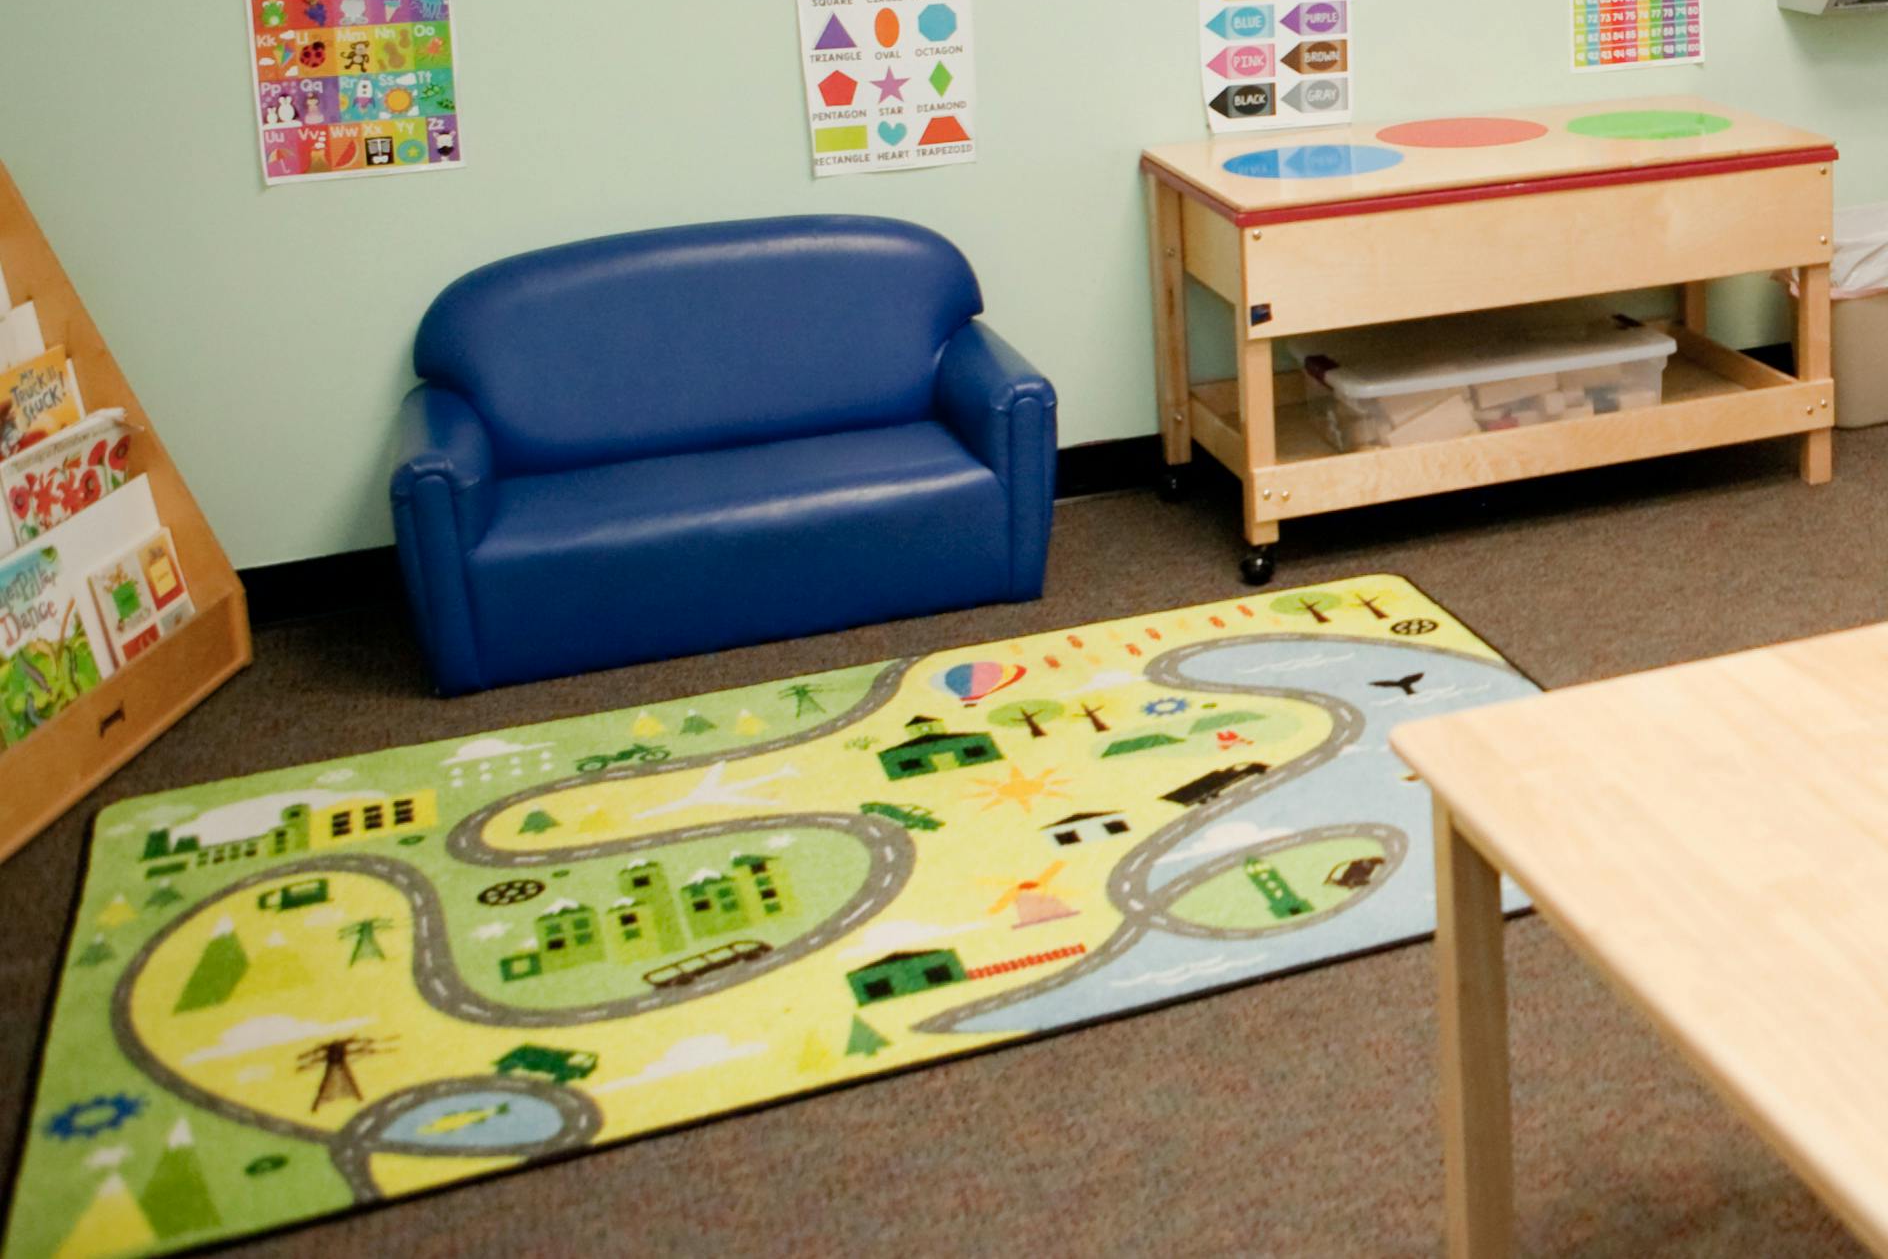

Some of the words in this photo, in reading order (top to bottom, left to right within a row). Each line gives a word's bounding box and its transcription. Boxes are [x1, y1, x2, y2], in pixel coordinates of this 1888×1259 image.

[1234, 16, 1262, 29] BLUE
[1305, 13, 1337, 24] PURPLE
[257, 35, 277, 47] Kk
[414, 25, 435, 37] Oo
[810, 52, 862, 63] TRIANGLE
[875, 52, 901, 60] OVAL
[915, 45, 963, 57] OCTAGON
[1233, 56, 1264, 69] PINK
[1305, 52, 1339, 63] BROWN
[261, 82, 281, 95] Pp
[300, 80, 323, 93] Qq
[339, 77, 355, 88] Rr
[378, 74, 395, 85] Ss
[1234, 94, 1266, 106] BLACK
[1307, 90, 1337, 101] GRAY
[813, 109, 866, 121] PENTAGON
[879, 107, 903, 116] STAR
[917, 100, 966, 113] DIAMOND
[266, 131, 285, 142] Uu
[299, 128, 318, 140] Vv
[330, 125, 358, 138] Ww
[428, 118, 444, 130] Zz
[815, 154, 870, 166] RECTANGLE
[877, 150, 909, 161] HEART
[916, 144, 972, 157] TRAPEZOID
[0, 600, 57, 645] Dance
